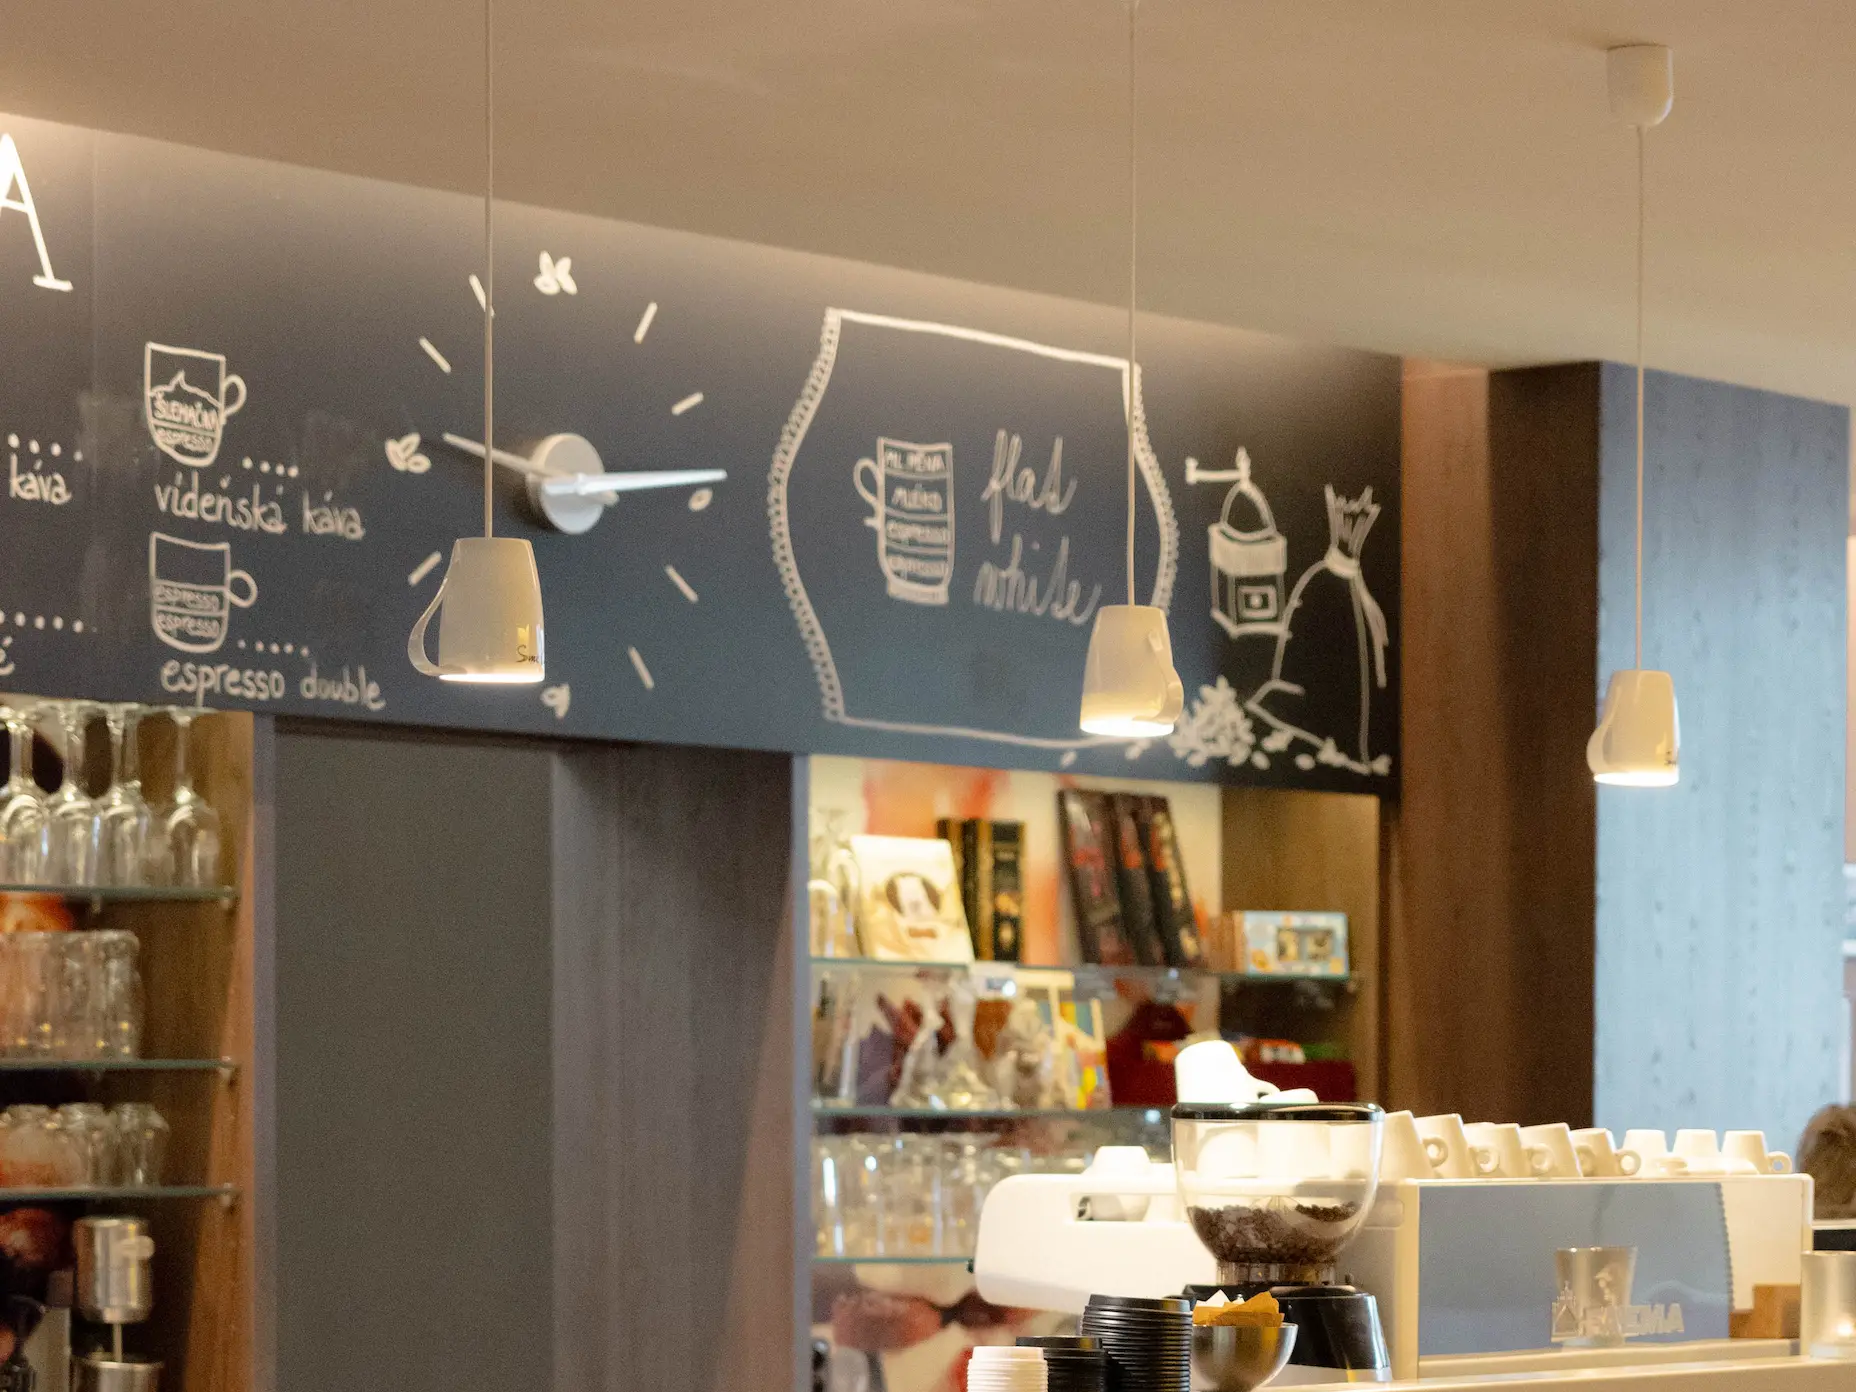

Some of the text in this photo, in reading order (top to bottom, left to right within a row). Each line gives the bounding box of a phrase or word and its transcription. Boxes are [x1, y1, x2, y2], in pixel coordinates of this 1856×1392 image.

[9, 452, 72, 505] káva
[302, 489, 366, 540] káva
[161, 659, 387, 711] espresso double
